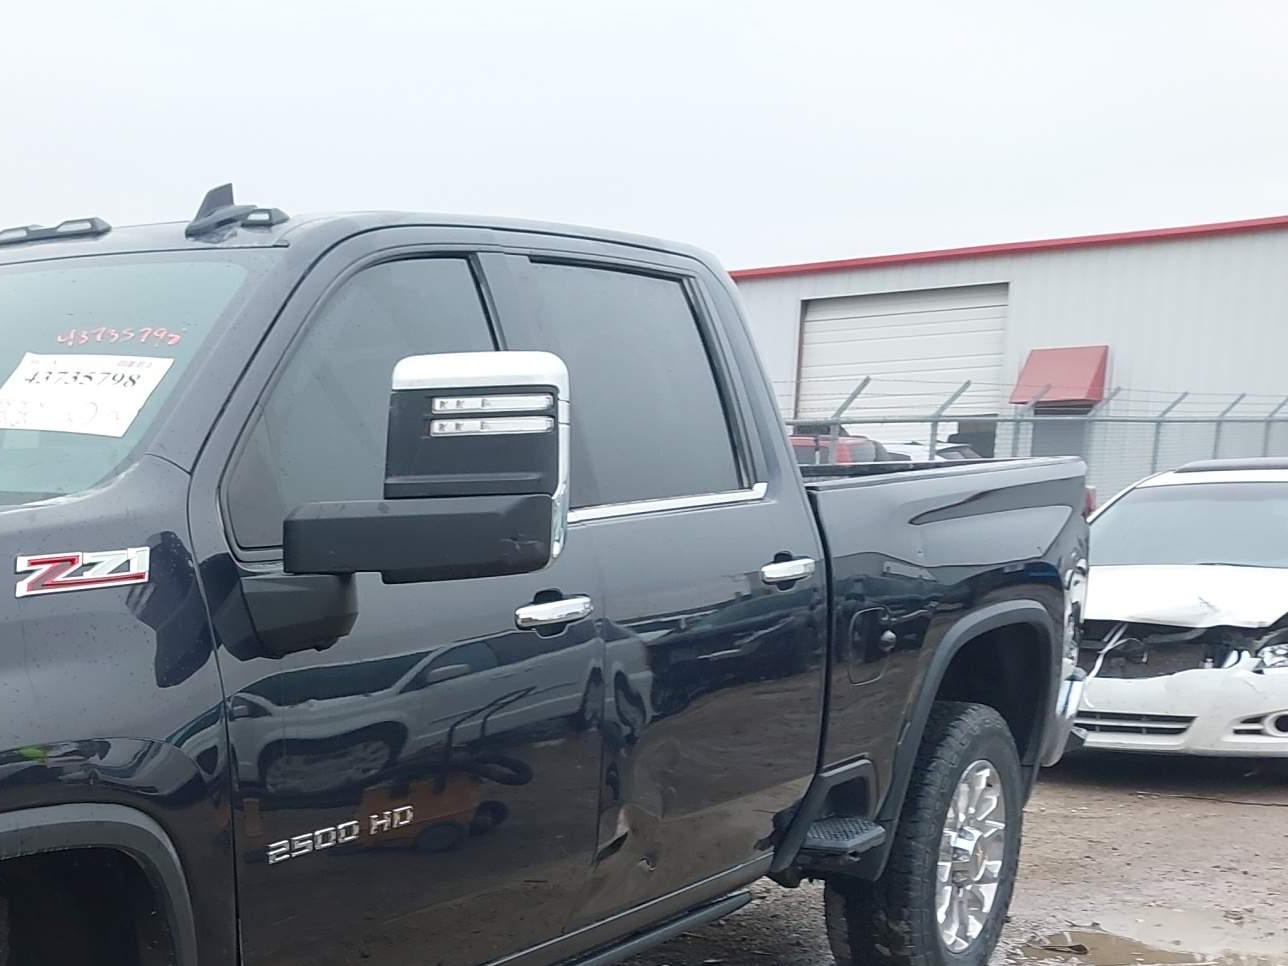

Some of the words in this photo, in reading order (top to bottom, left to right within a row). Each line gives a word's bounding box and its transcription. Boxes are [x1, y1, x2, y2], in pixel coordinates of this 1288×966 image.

[24, 371, 141, 387] 43735798
[15, 547, 150, 598] Z71
[266, 820, 360, 865] 2500
[368, 805, 414, 835] HD
